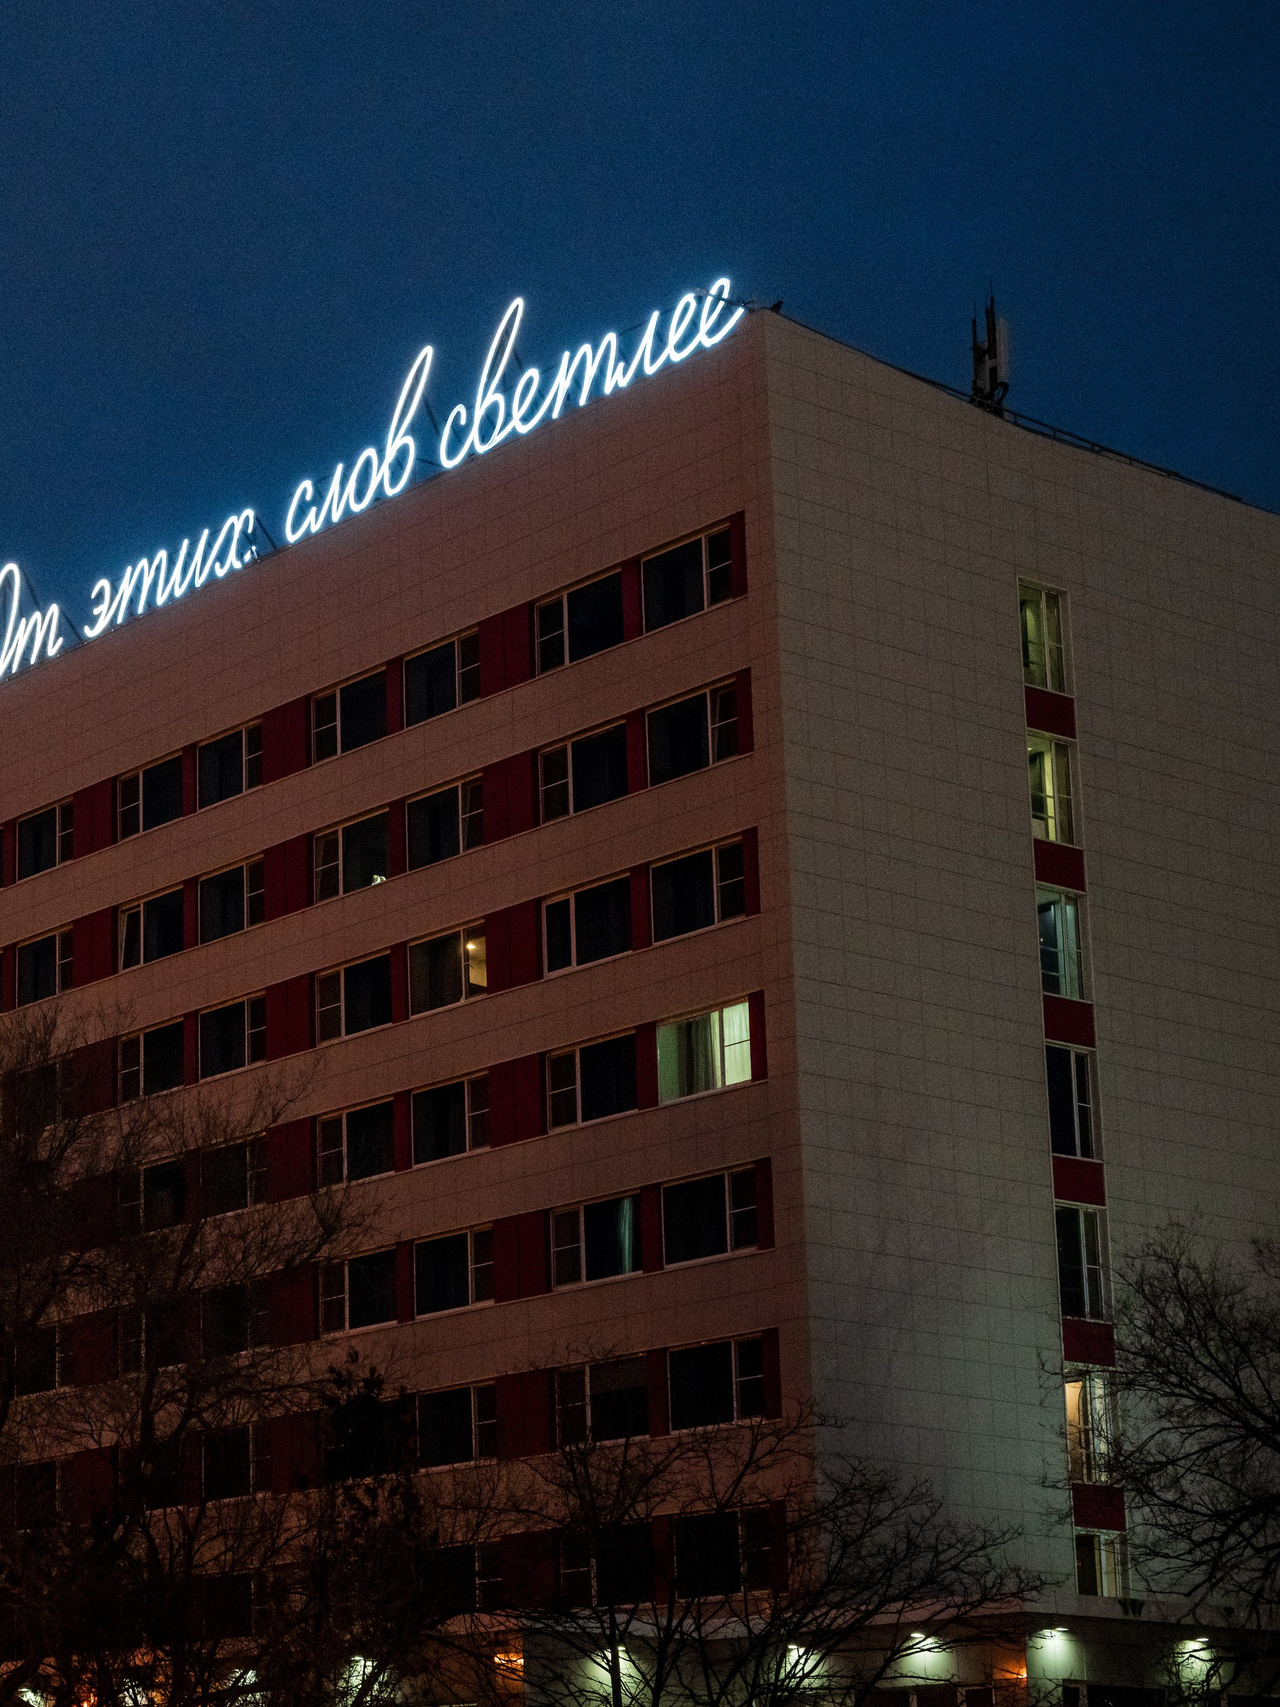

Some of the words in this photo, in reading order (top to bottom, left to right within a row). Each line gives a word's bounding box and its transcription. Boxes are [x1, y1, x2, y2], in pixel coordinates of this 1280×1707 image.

[84, 508, 257, 638] этих
[285, 345, 434, 543] слов
[439, 277, 745, 469] светлее
